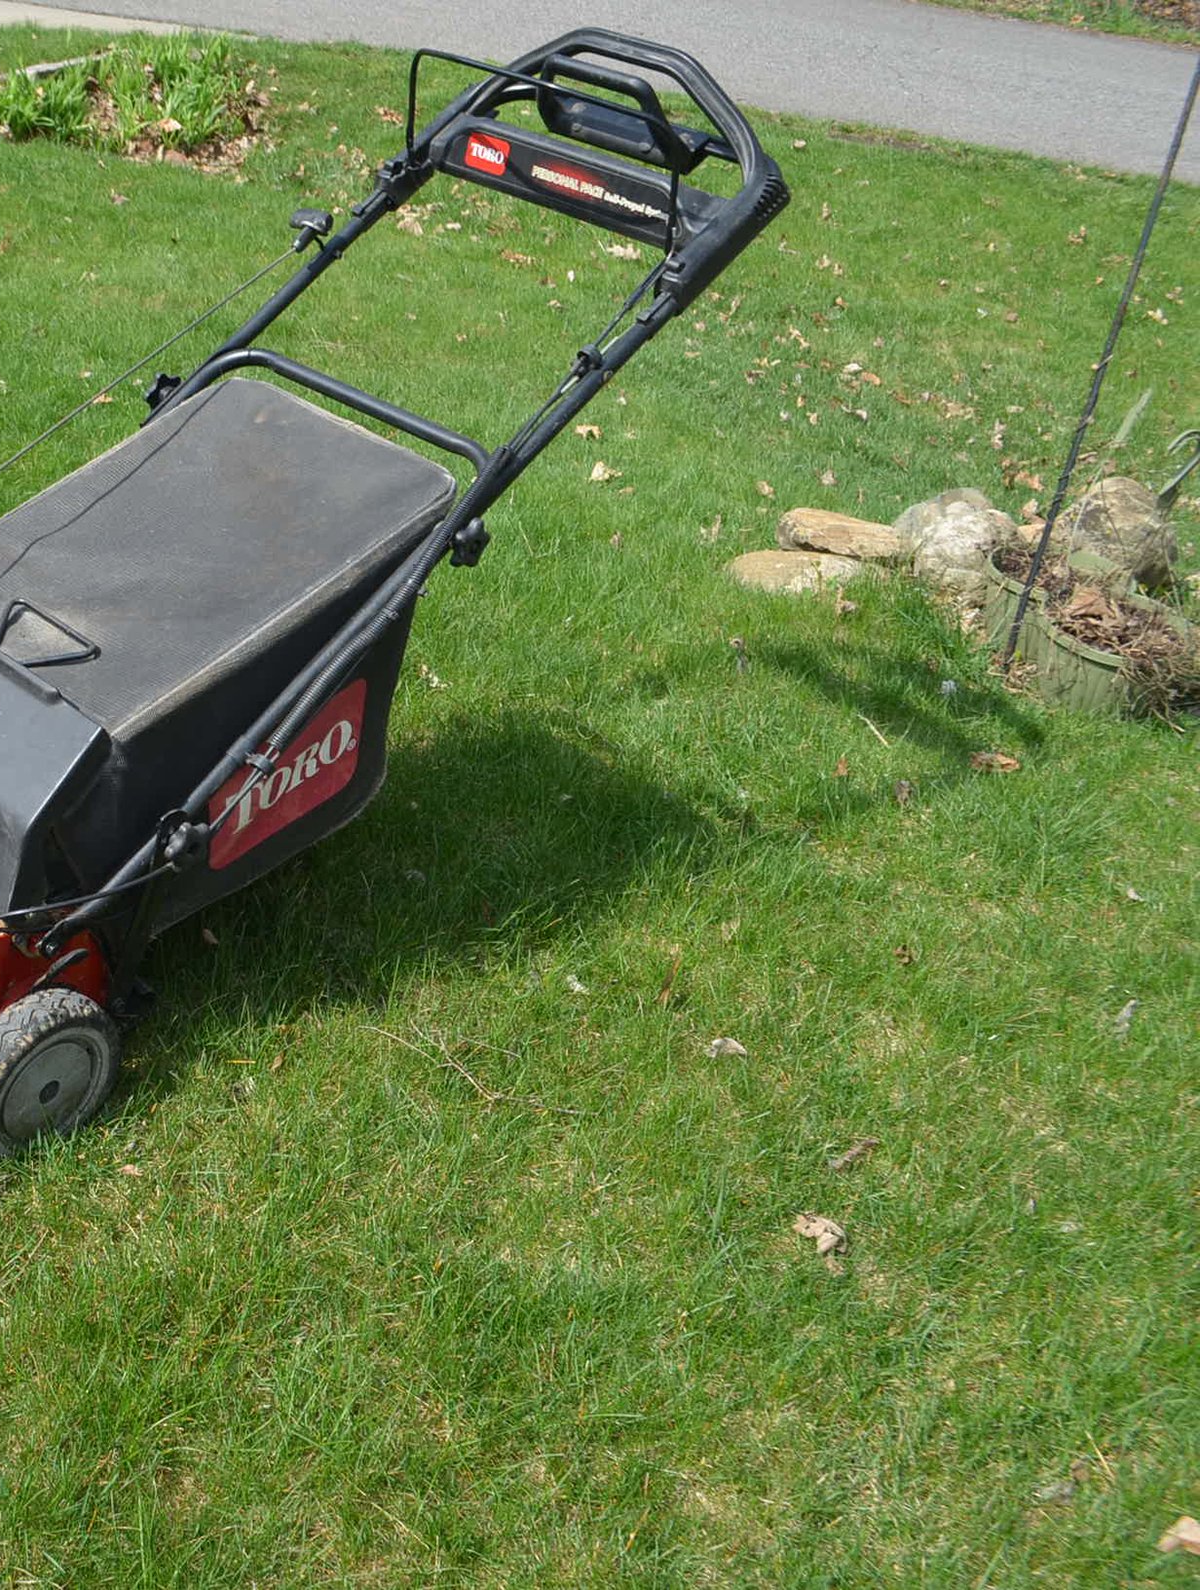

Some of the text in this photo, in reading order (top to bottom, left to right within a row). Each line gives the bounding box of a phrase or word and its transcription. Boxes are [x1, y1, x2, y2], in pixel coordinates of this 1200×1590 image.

[470, 142, 504, 165] TORO
[531, 164, 579, 192] PERSONAL
[580, 181, 604, 200] PACE
[226, 720, 353, 835] TORO
